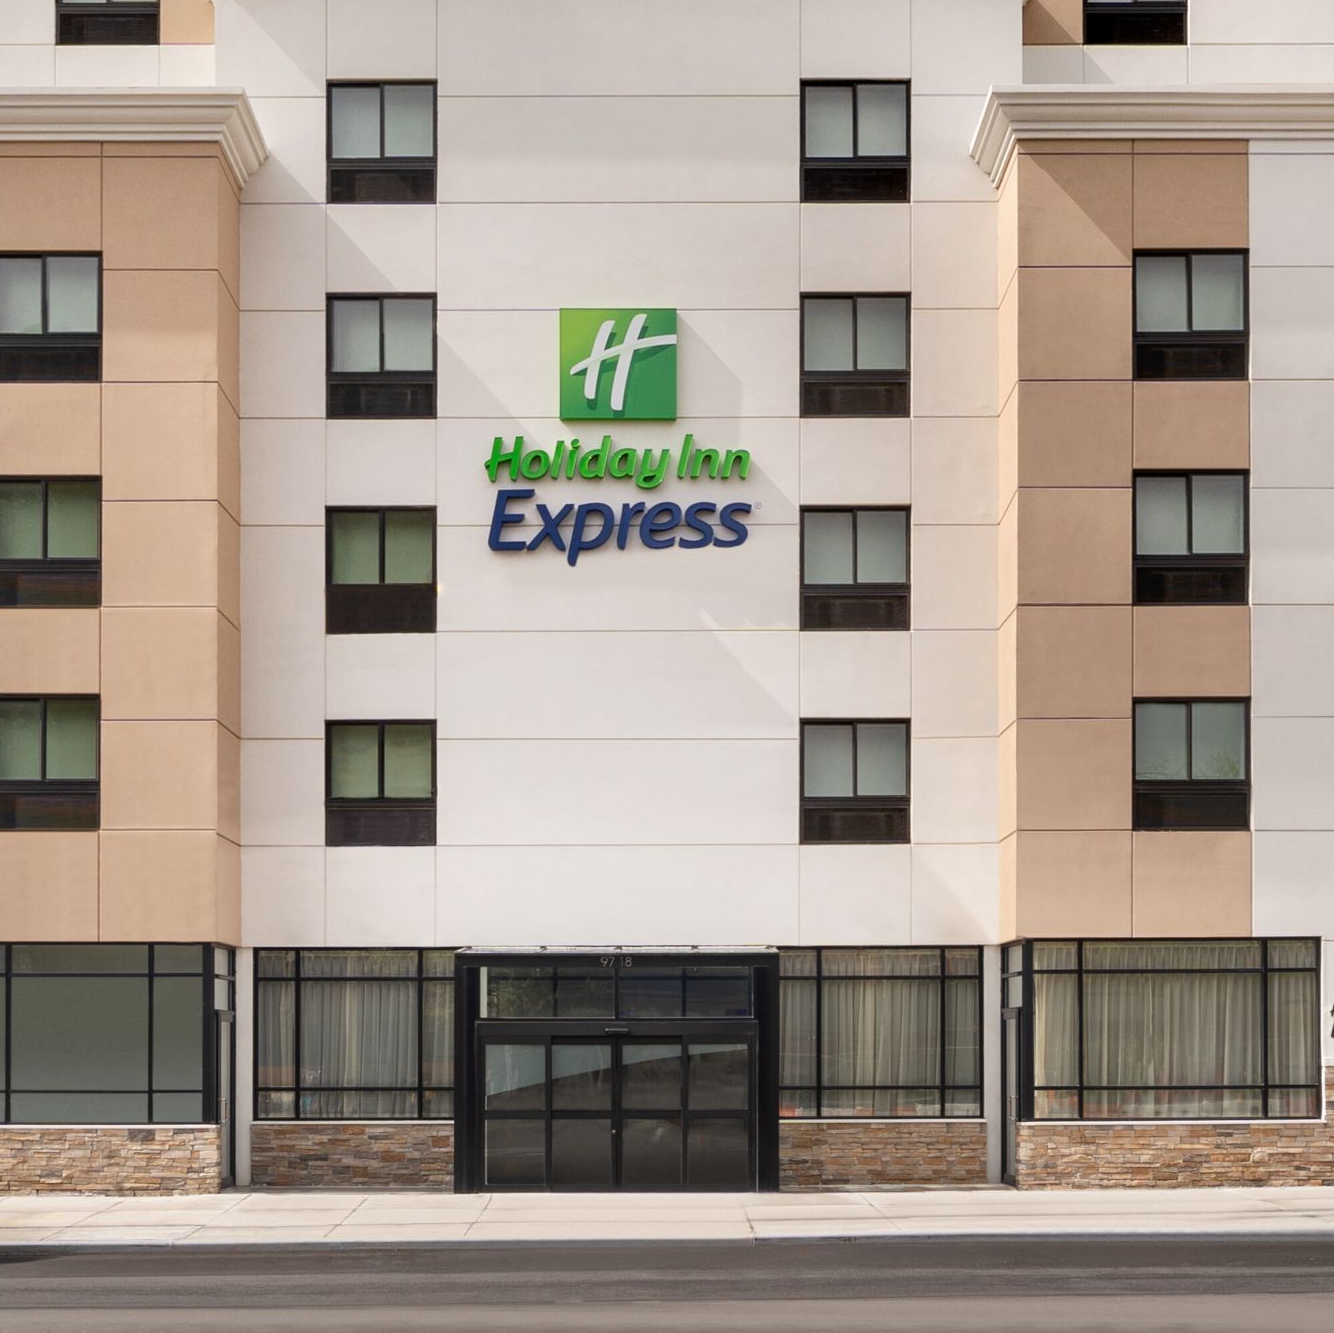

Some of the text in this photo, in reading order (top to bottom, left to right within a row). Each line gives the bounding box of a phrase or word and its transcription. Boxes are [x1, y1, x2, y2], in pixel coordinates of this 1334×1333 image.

[484, 434, 751, 490] Holiday Inn
[488, 489, 752, 567] Express
[600, 956, 633, 967] 97 18
